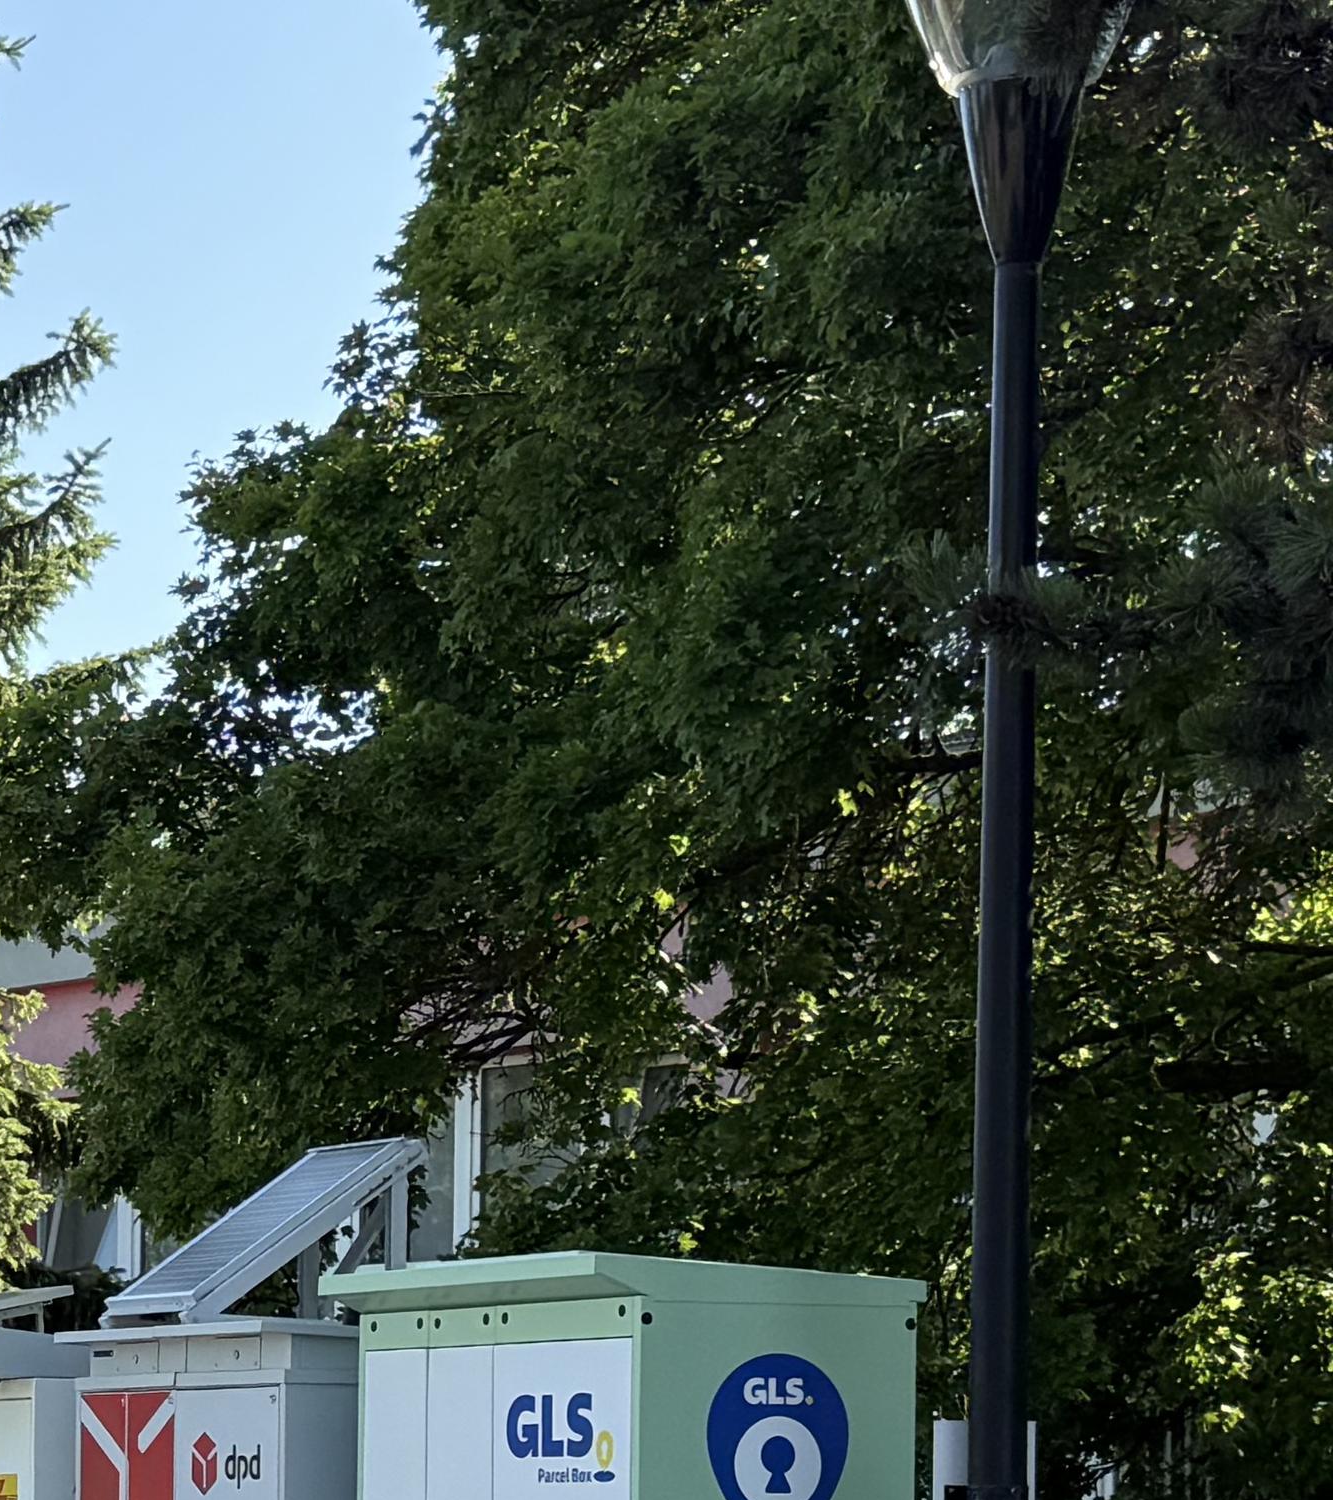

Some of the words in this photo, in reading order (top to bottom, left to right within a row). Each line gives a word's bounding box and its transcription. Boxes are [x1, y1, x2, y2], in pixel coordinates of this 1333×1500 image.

[506, 1392, 593, 1459] GLS
[224, 1444, 261, 1489] dpd
[538, 1467, 569, 1483] Parcel
[572, 1469, 593, 1483] Box
